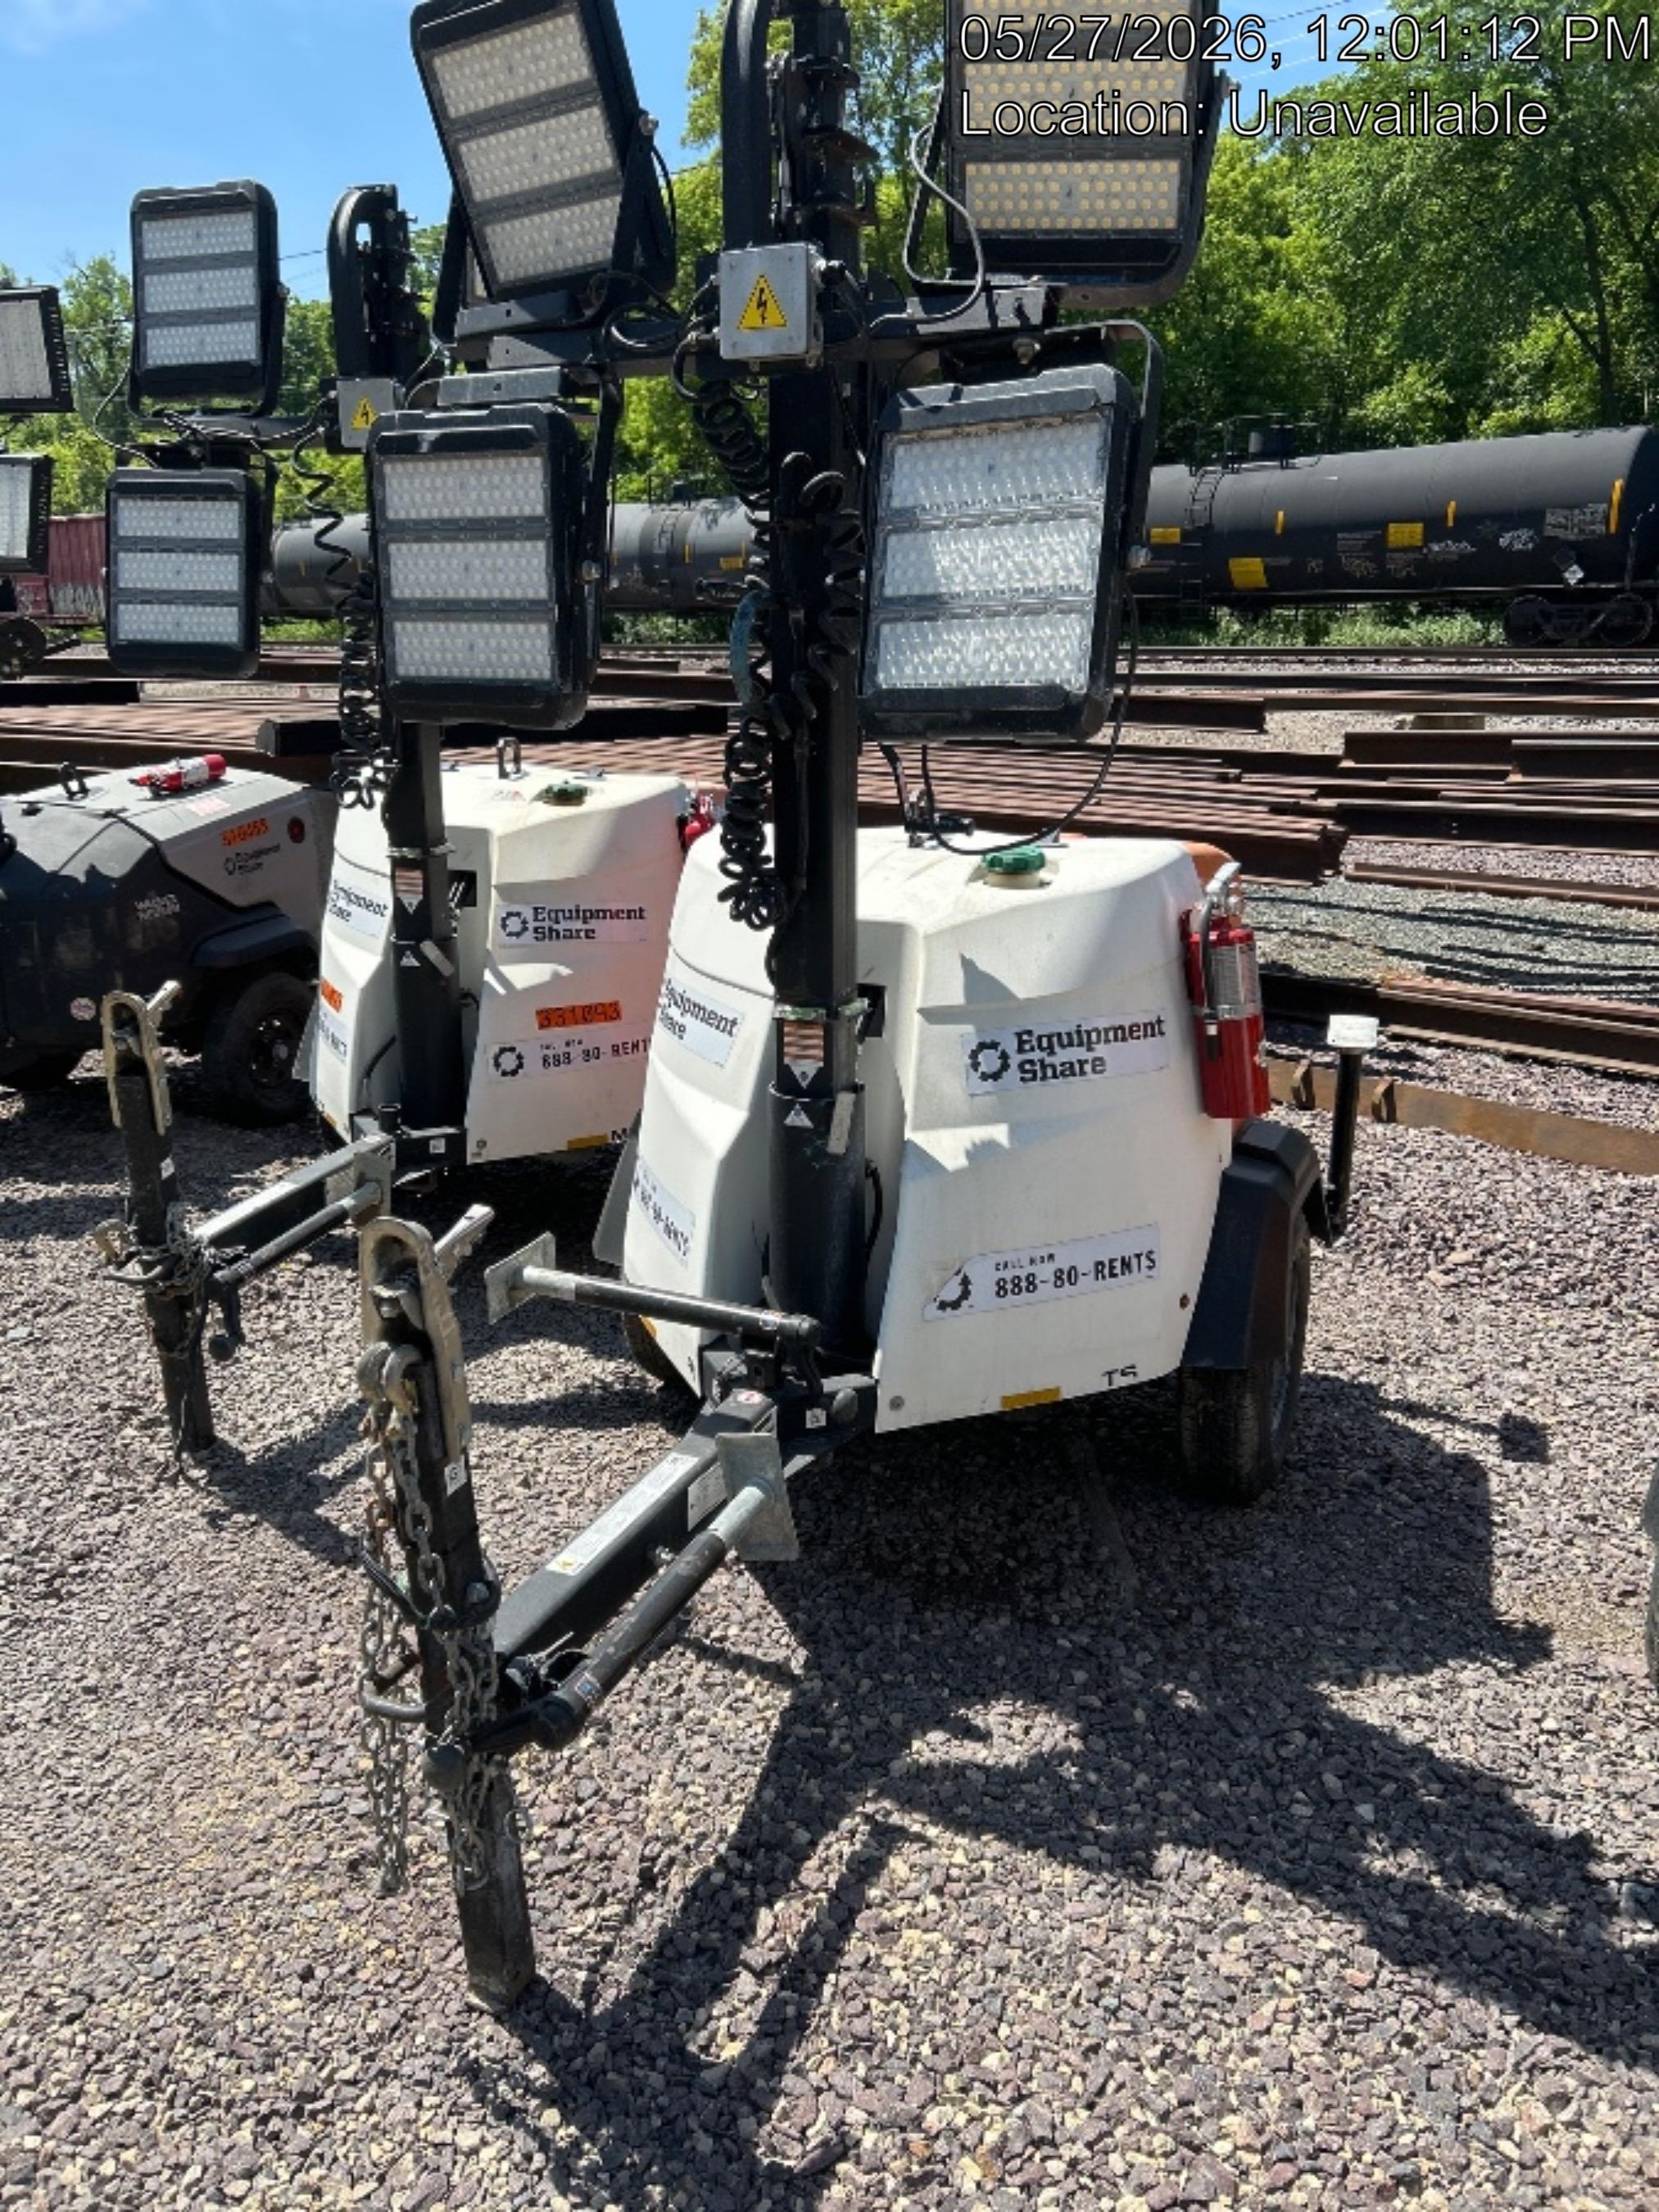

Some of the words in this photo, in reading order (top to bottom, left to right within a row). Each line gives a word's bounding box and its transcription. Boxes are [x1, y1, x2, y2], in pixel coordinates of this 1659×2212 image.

[533, 904, 646, 924] Equipment
[533, 925, 596, 942] Share
[1014, 1014, 1166, 1057] Equipment
[542, 1036, 652, 1069] 888-80-RENT
[1017, 1056, 1107, 1083] Share
[995, 1249, 1157, 1299] 888-80-RENTS
